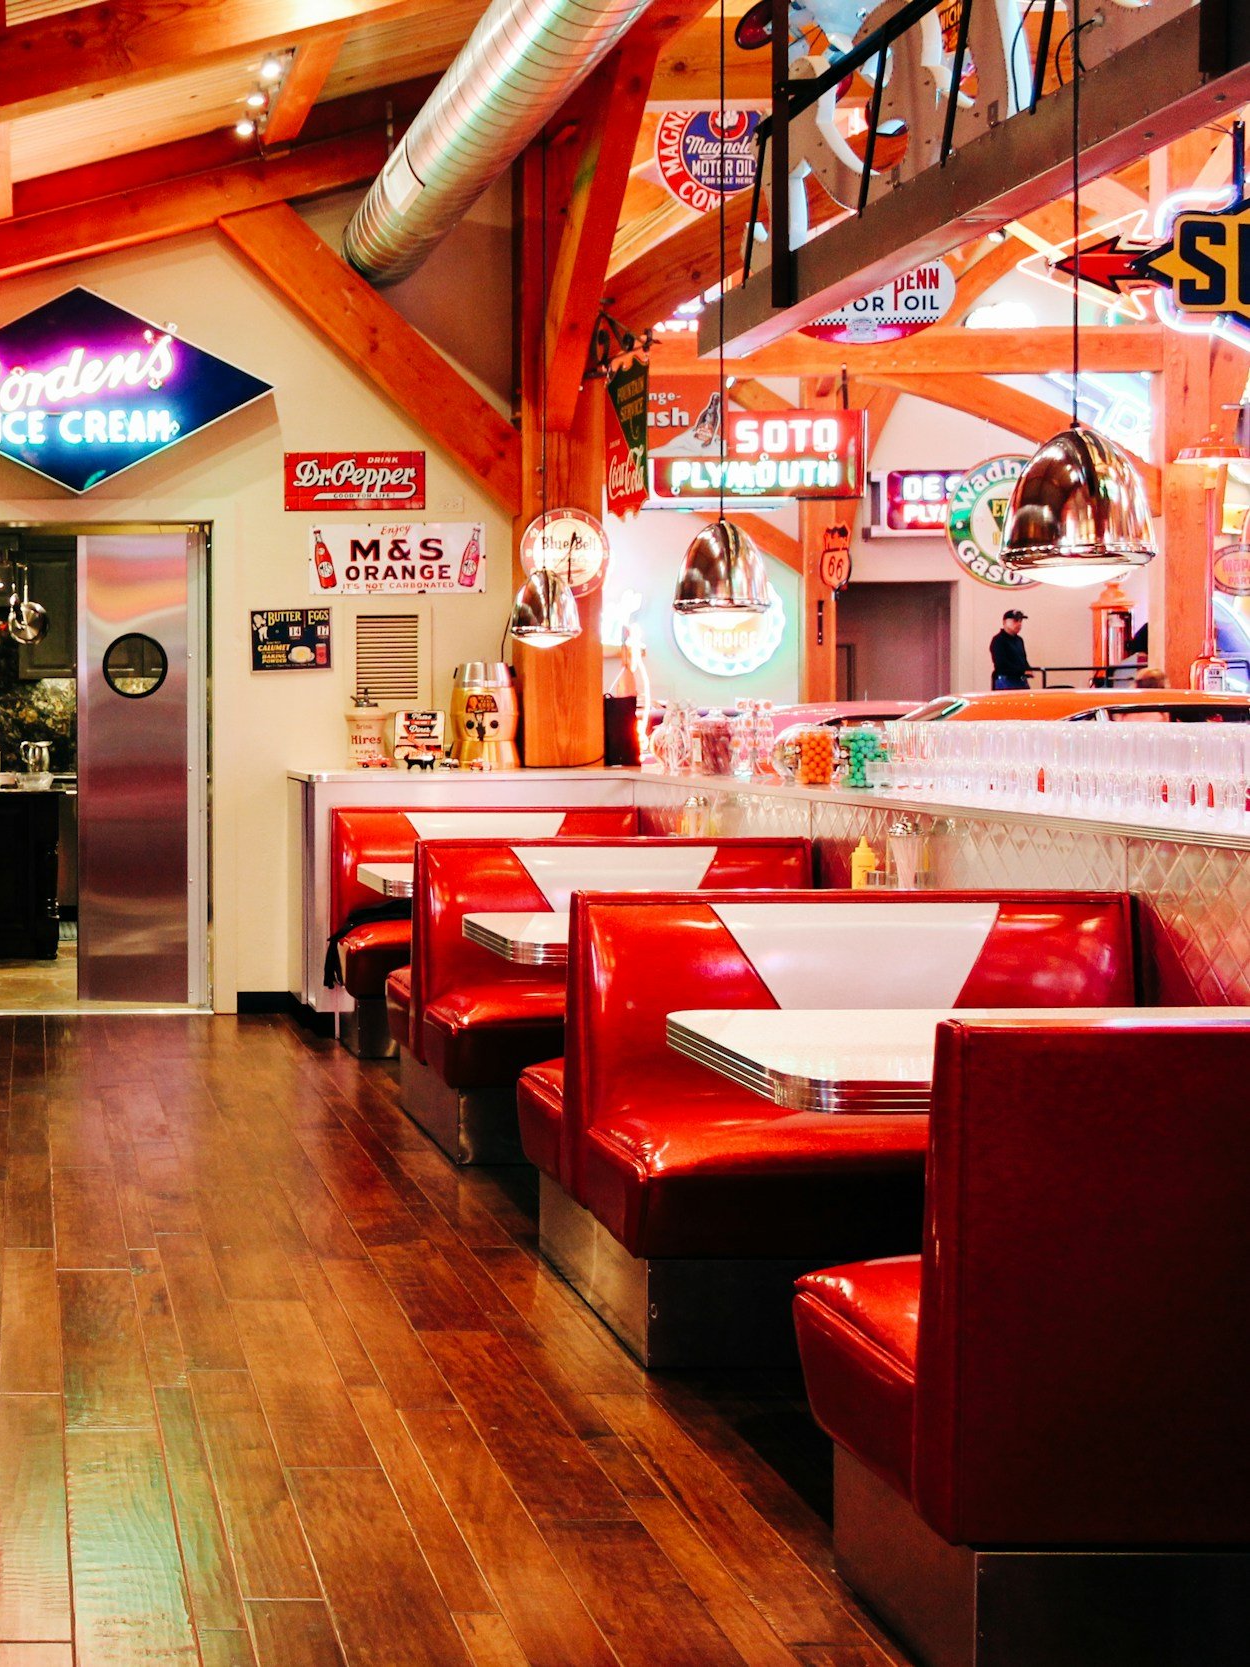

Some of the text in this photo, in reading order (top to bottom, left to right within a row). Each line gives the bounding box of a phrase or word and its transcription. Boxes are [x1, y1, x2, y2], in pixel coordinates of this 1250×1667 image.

[736, 159, 756, 176] OIL
[904, 295, 939, 311] OIL
[59, 409, 171, 445] CREAM
[735, 418, 839, 453] SOTO
[367, 456, 399, 465] DRINK
[671, 460, 839, 489] PLYMOUTH
[903, 476, 941, 501] DE
[380, 525, 412, 537] Enjoy
[542, 536, 596, 551] Blue Bell
[345, 565, 451, 581] ORANGE
[828, 555, 845, 581] 66
[343, 581, 455, 590] IT'S NOT CARBONATED
[268, 610, 329, 626] BUTTER EGGS
[257, 644, 291, 652] CALUMET
[351, 734, 382, 745] Hires
